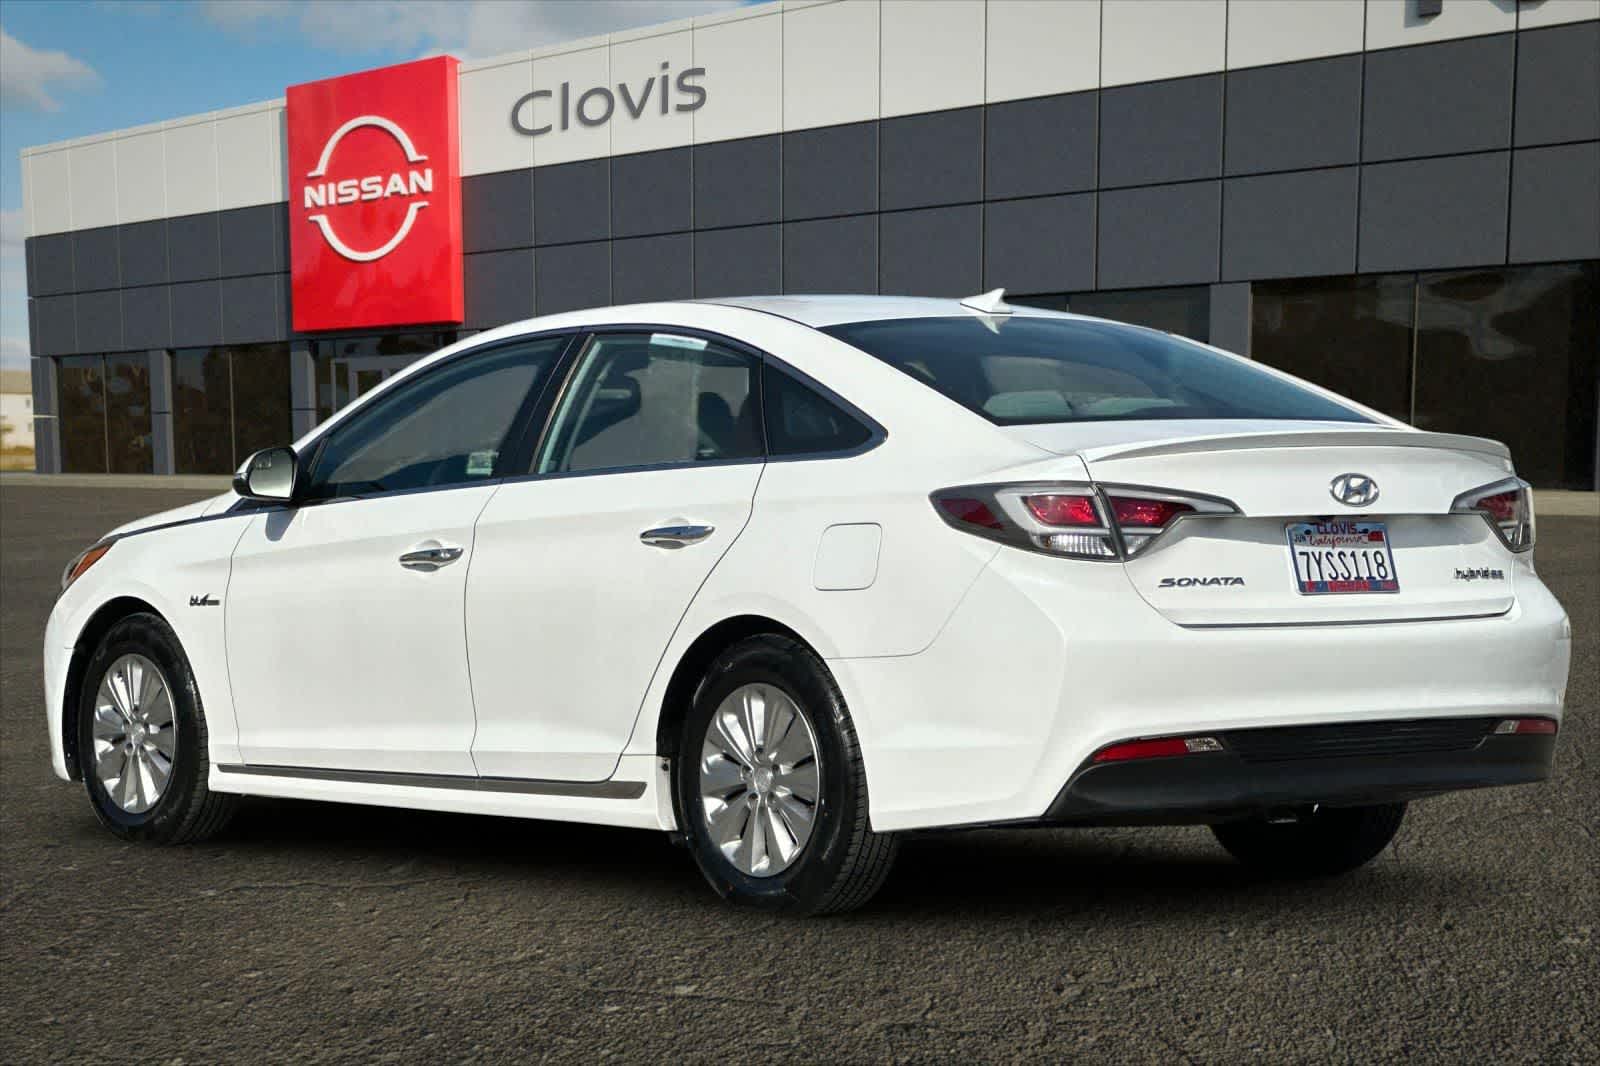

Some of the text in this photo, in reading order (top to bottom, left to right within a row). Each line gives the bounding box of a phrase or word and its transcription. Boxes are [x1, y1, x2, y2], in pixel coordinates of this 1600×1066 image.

[511, 61, 707, 136] Clovis
[304, 168, 433, 209] NISSAN
[1316, 521, 1357, 535] CLOVIS
[1309, 535, 1362, 548] California
[1298, 550, 1388, 581] 7YSS118
[1158, 577, 1245, 588] SONATA
